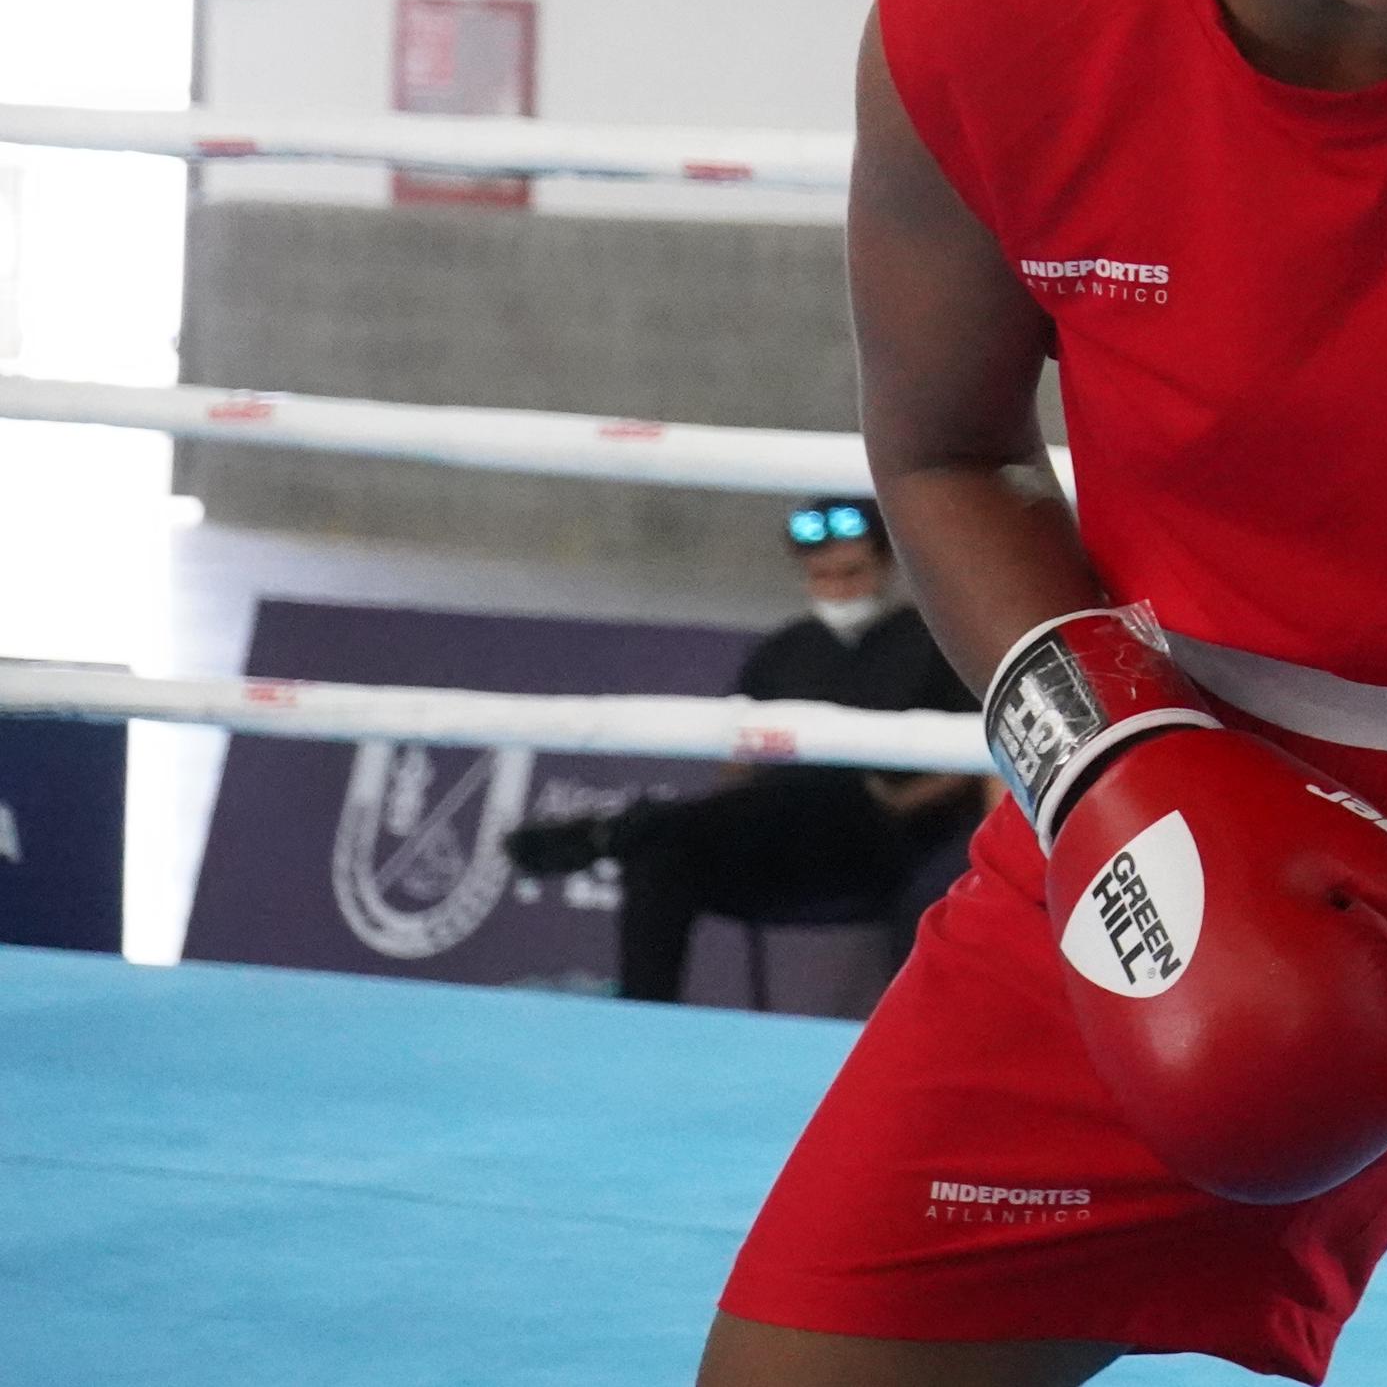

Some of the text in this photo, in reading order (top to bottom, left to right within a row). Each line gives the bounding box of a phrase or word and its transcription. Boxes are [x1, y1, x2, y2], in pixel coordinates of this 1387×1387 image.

[1020, 258, 1169, 284] INDEPORTES
[1091, 871, 1137, 986] HILL
[1112, 851, 1183, 981] GREEN
[930, 1181, 1092, 1205] INDEPORTES
